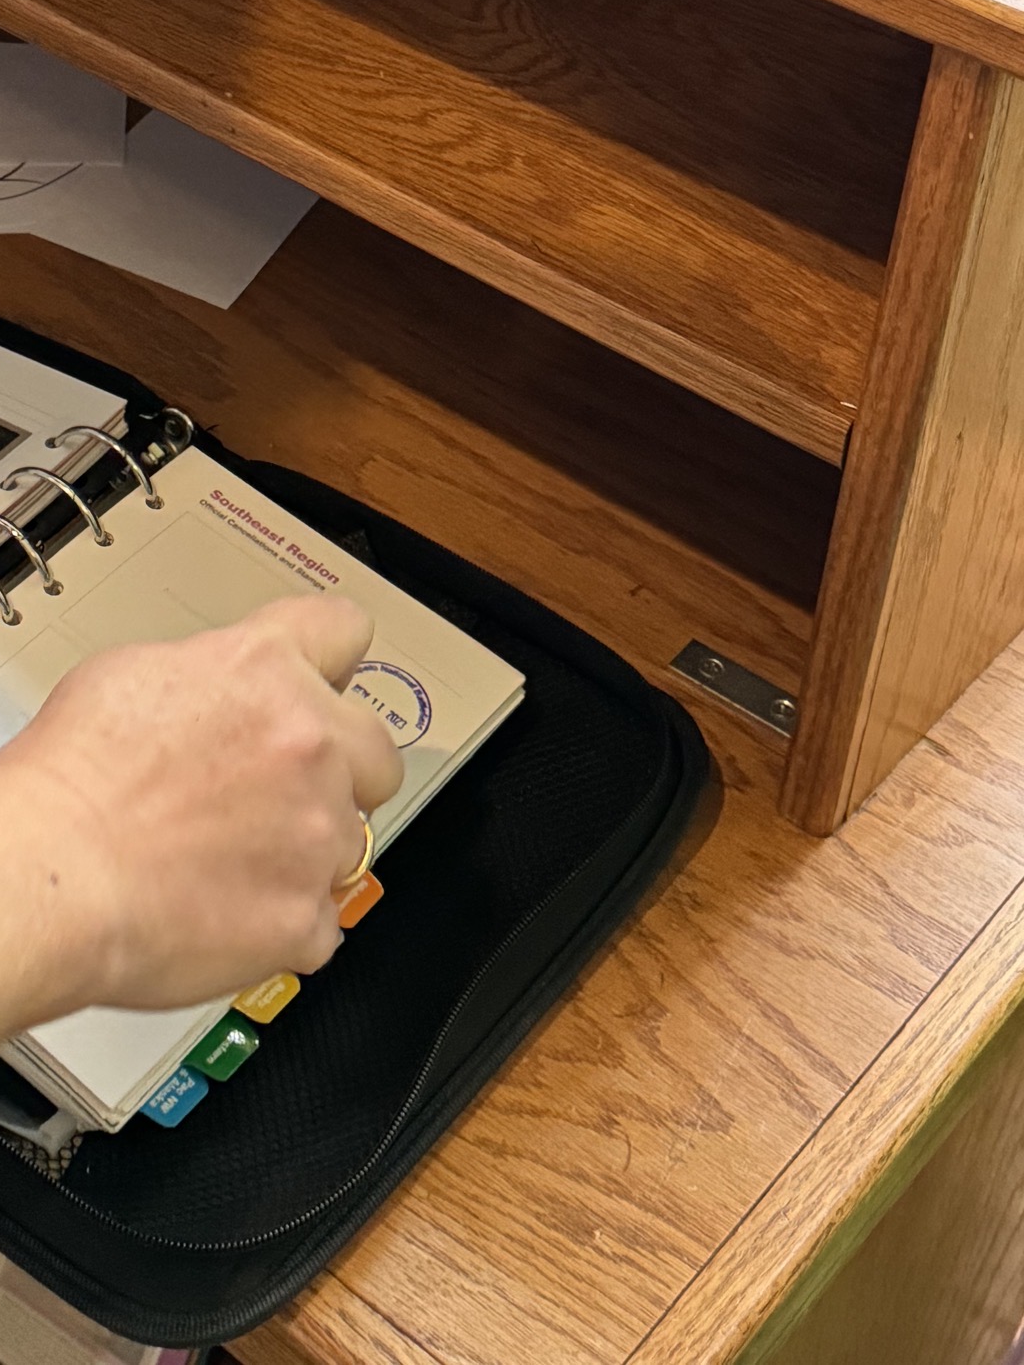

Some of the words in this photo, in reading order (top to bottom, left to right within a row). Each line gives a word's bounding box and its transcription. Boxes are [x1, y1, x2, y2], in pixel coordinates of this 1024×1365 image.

[199, 498, 228, 521] Official
[278, 556, 296, 570] and
[295, 566, 326, 592] Stamps
[209, 489, 286, 546] Southeast
[285, 543, 341, 585] Region
